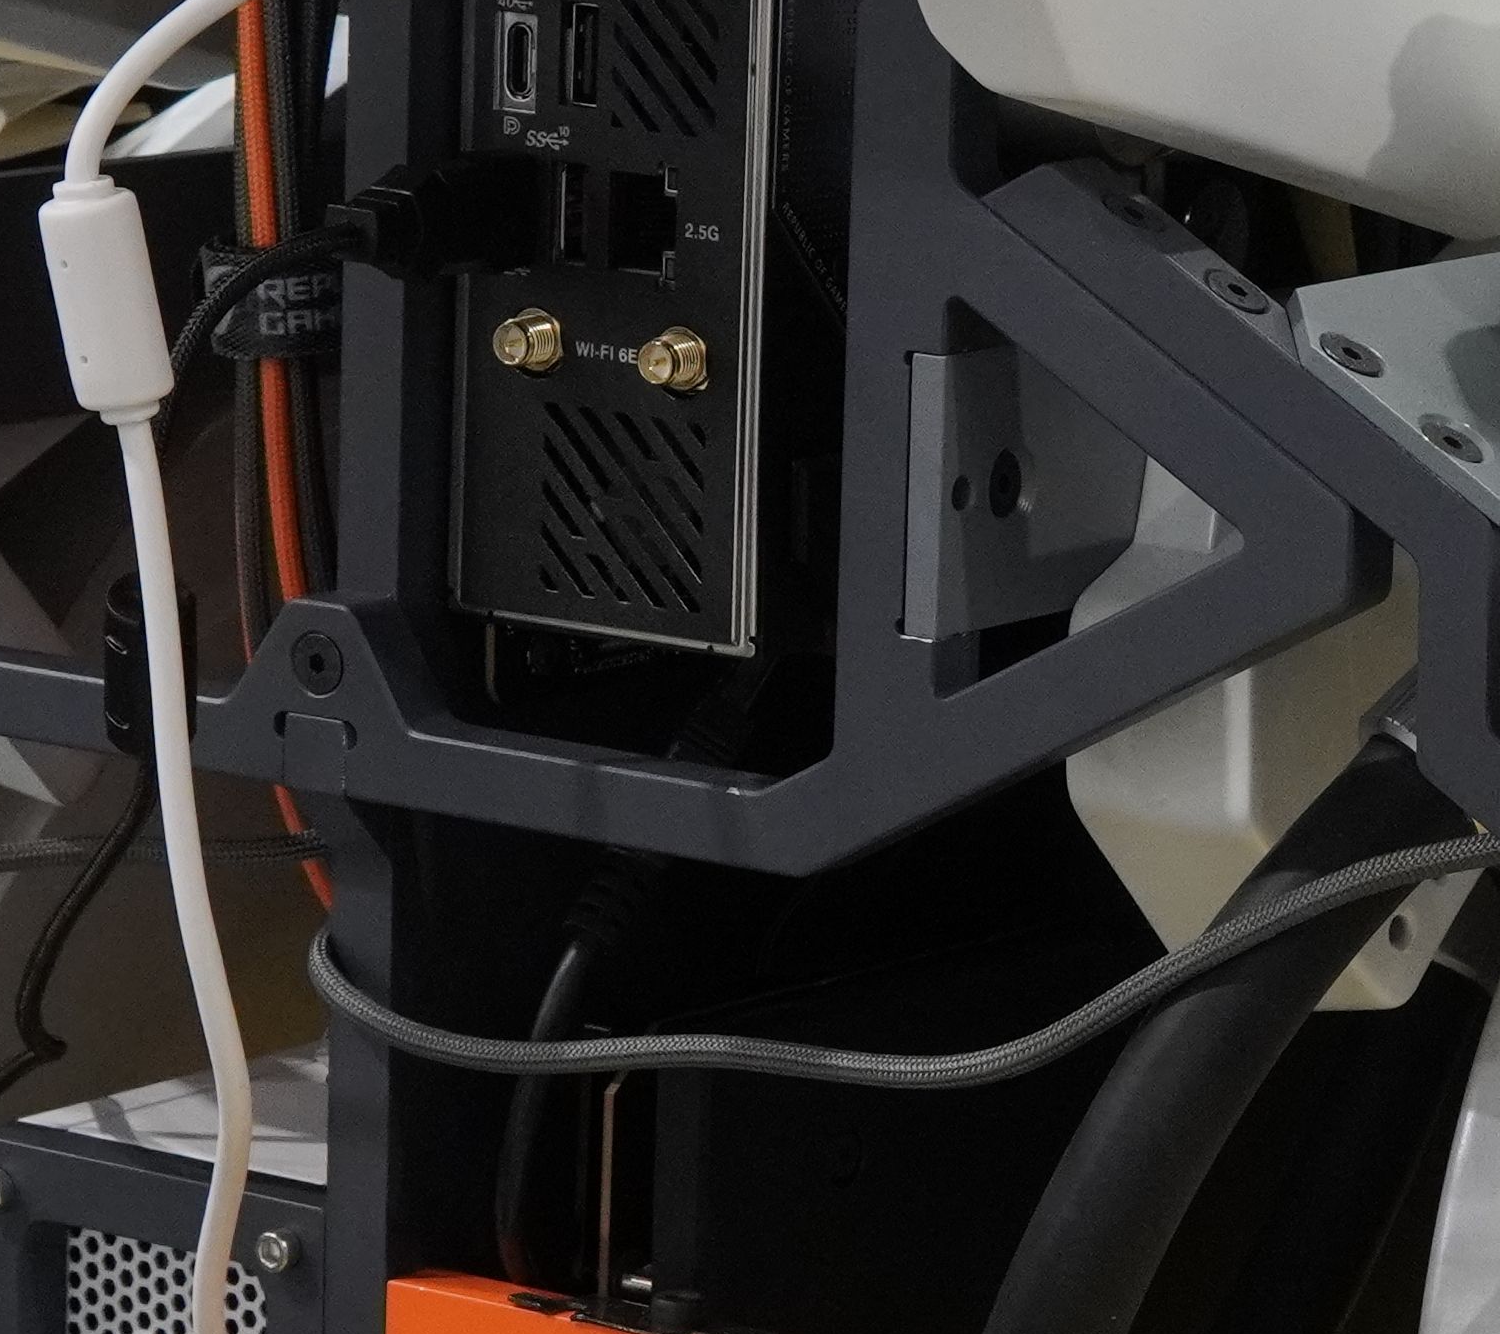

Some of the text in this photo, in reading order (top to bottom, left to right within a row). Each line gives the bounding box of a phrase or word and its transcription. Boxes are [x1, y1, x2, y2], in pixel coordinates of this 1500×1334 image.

[684, 222, 720, 242] 2.5G
[782, 202, 816, 260] REPUBLIC
[576, 340, 638, 365] WI-FI 6E
